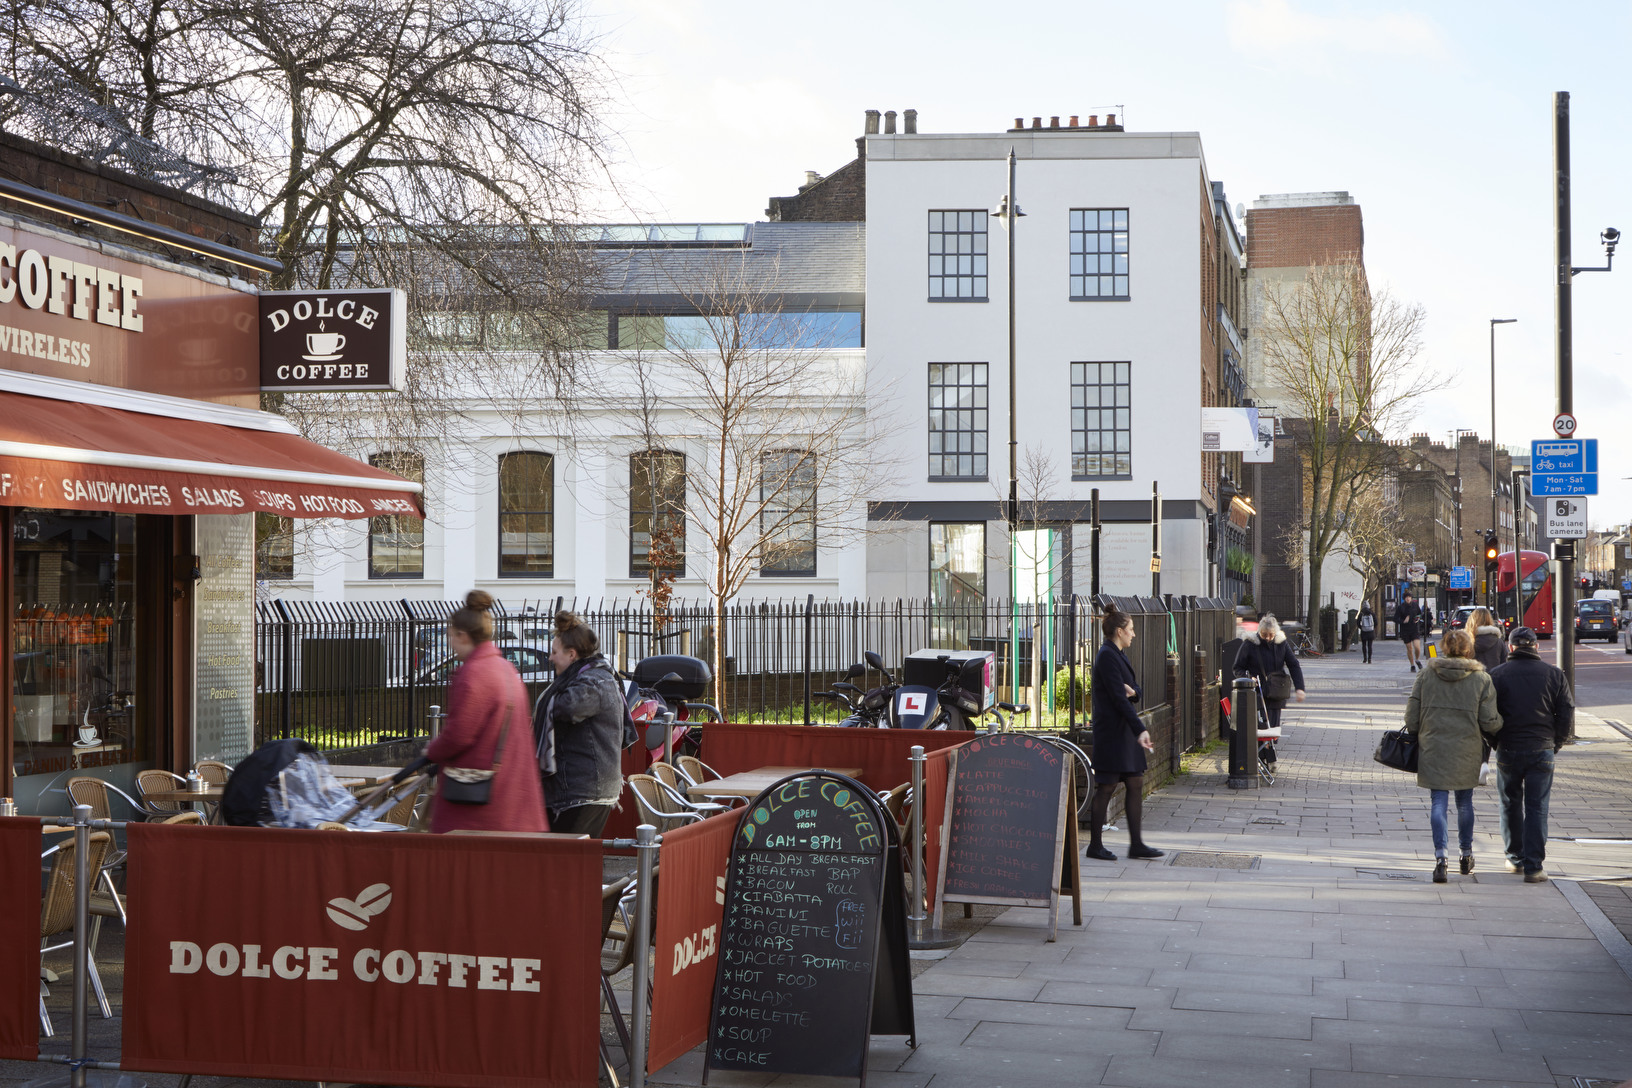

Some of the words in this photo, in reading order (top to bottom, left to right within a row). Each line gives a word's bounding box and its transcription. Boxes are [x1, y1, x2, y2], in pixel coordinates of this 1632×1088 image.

[268, 298, 379, 332] DOLCE
[277, 364, 369, 380] COFFEE
[1557, 420, 1574, 430] 20
[1547, 476, 1564, 484] Mon
[1569, 476, 1583, 484] Sat
[62, 479, 171, 507] SANDWICHES
[182, 487, 245, 508] SALADS
[253, 490, 296, 511] SOUPS
[300, 495, 331, 512] HOT
[328, 496, 365, 514] FOOD
[206, 555, 216, 567] All
[217, 555, 243, 568] Coffees
[1151, 559, 1160, 571] H
[203, 587, 245, 602] Sandwiches
[207, 620, 241, 633] Breakfast
[208, 653, 221, 667] Hot
[222, 652, 241, 666] Food
[210, 687, 238, 700] Pastries
[905, 697, 919, 710] L
[959, 735, 1007, 762] DOLCE
[1013, 735, 1058, 767] COFFEE
[24, 755, 67, 775] PANINI
[967, 770, 1005, 779] LATTE
[965, 783, 1048, 800] CAPPUCCINO
[741, 780, 811, 848] DOLCE
[820, 782, 880, 851] COFFEE
[793, 808, 818, 820] OPEN
[964, 807, 1008, 817] MOCHA
[765, 834, 796, 848] 6AM
[810, 835, 842, 850] 8PM
[775, 853, 803, 865] DAY
[809, 853, 877, 865] BREAKFAST
[827, 868, 860, 880] BAP
[955, 863, 976, 873] ICE
[826, 883, 857, 895] ROLL
[842, 901, 866, 912] FREE
[672, 923, 717, 976] DOLCE
[169, 941, 338, 980] DOLCE
[352, 948, 541, 993] COFFEE
[735, 970, 763, 983] HOT
[777, 973, 817, 989] FOOD
[728, 1027, 772, 1043] SOUP
[724, 1048, 772, 1065] CAKE
